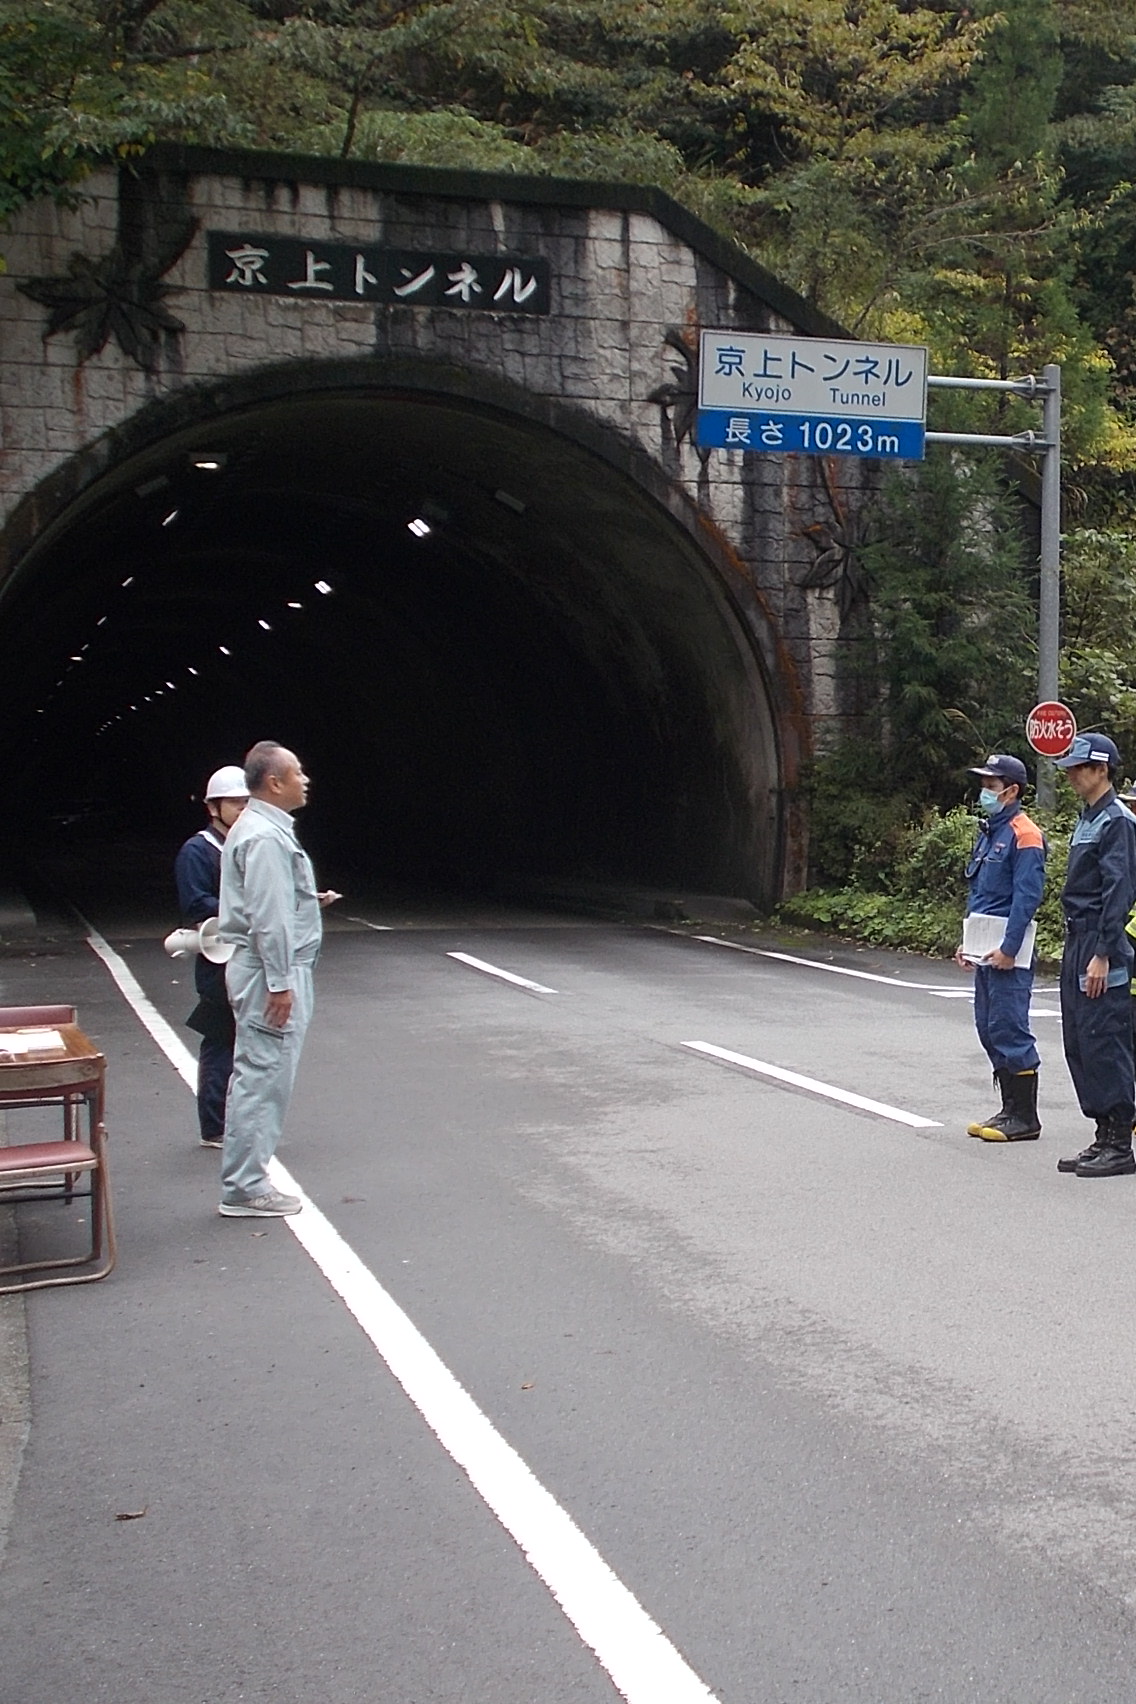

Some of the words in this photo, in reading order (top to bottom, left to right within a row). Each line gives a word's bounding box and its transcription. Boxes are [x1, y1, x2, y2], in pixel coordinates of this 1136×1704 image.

[225, 243, 537, 303] 京上トンネル
[714, 345, 913, 387] 京上トンネル
[742, 381, 792, 403] Kyojo
[829, 387, 886, 407] Tunnel
[1030, 719, 1073, 740] 防火水そう
